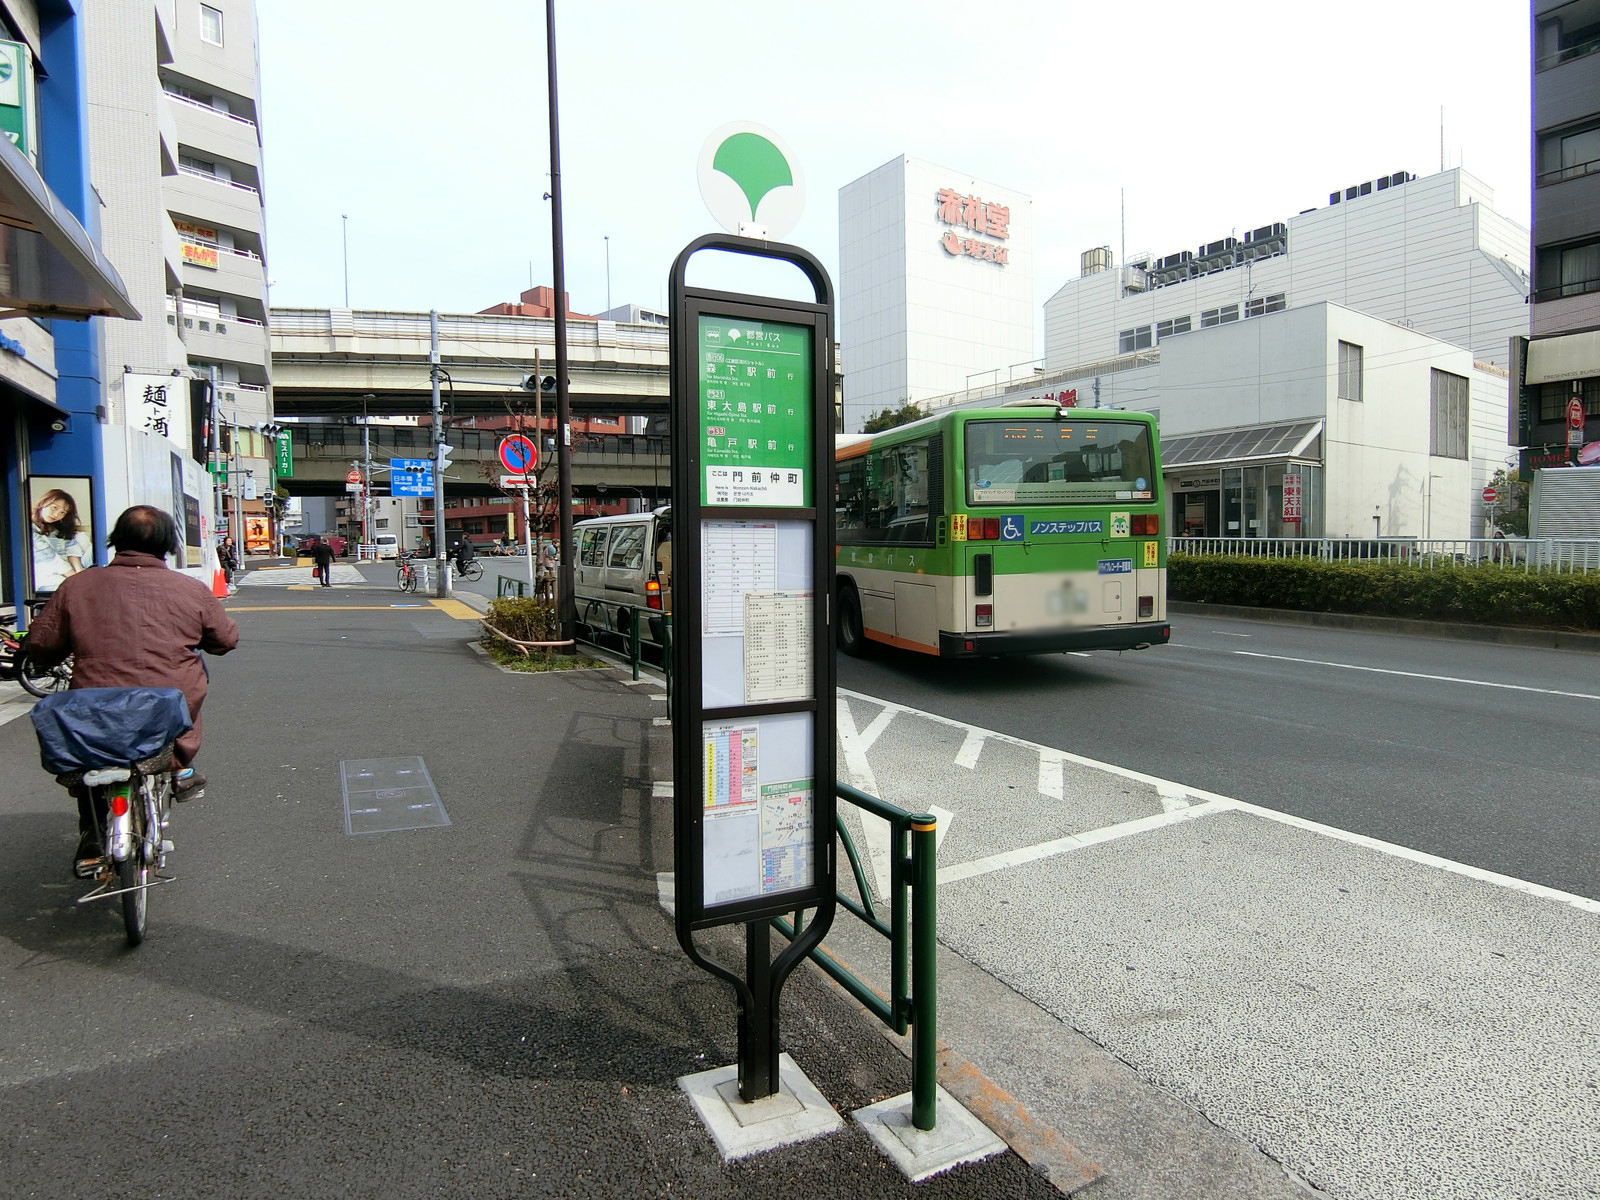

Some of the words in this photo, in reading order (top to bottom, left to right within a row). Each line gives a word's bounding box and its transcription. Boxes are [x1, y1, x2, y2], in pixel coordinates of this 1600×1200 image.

[937, 188, 1010, 239] 赤札堂
[966, 239, 1009, 264] 東天紅
[746, 330, 781, 342] 都営バス
[707, 400, 794, 416] 東大島駅前行
[281, 441, 289, 474] モスバーガー
[732, 471, 798, 484] 門前仲町
[1033, 521, 1102, 534] ノンステップバス
